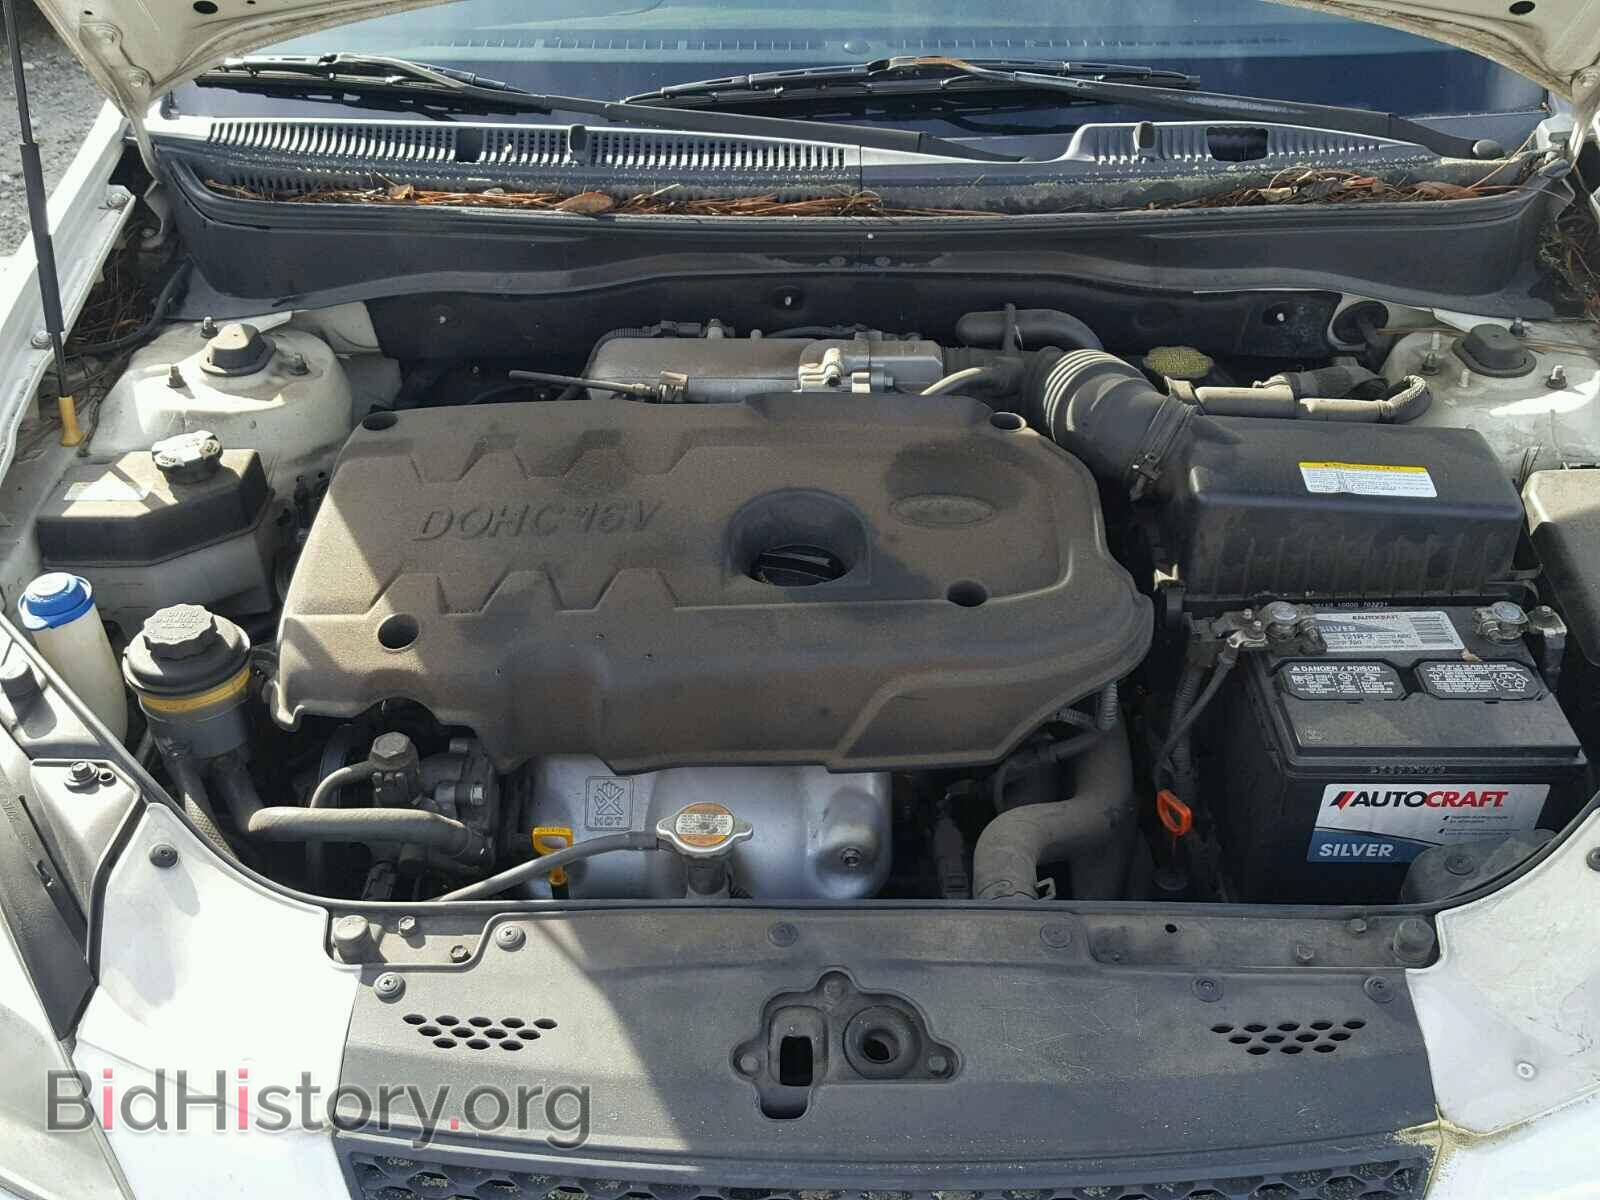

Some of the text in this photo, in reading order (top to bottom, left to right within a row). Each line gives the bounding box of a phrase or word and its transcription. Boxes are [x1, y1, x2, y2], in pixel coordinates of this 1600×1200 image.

[411, 498, 667, 542] DOHC 16V
[1350, 790, 1509, 808] AUTOCRAFT
[594, 816, 623, 827] HOT
[1319, 843, 1395, 857] SILVER
